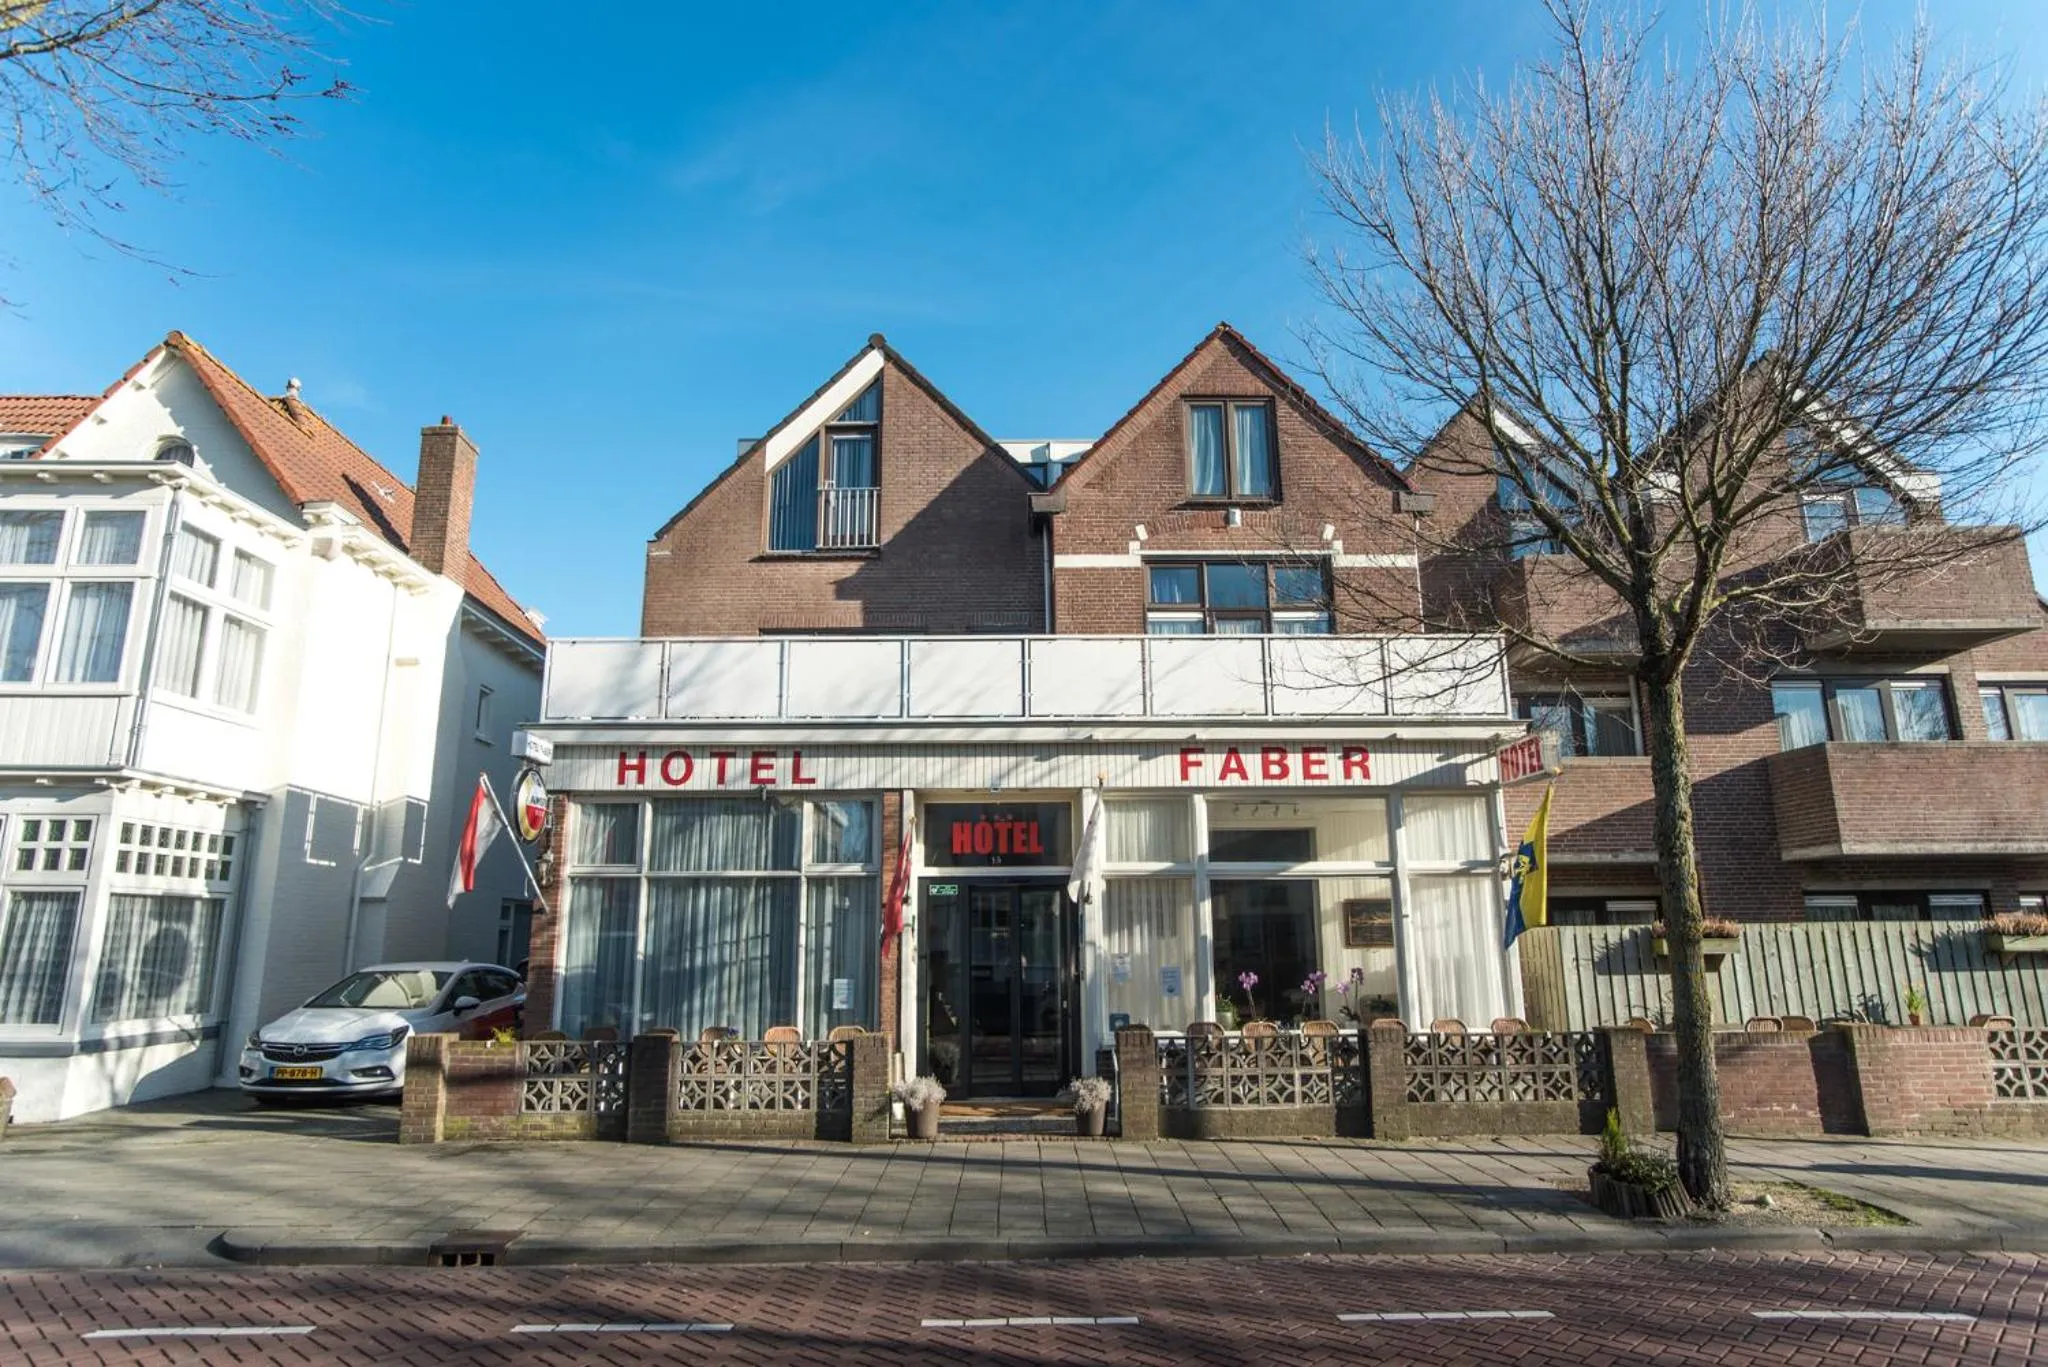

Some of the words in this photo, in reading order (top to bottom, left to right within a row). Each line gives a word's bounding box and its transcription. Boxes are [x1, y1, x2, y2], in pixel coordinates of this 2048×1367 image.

[617, 750, 816, 786] HOTEL
[1180, 746, 1371, 781] FABER
[1500, 737, 1544, 782] HOTEL
[952, 821, 1044, 854] HOTEL
